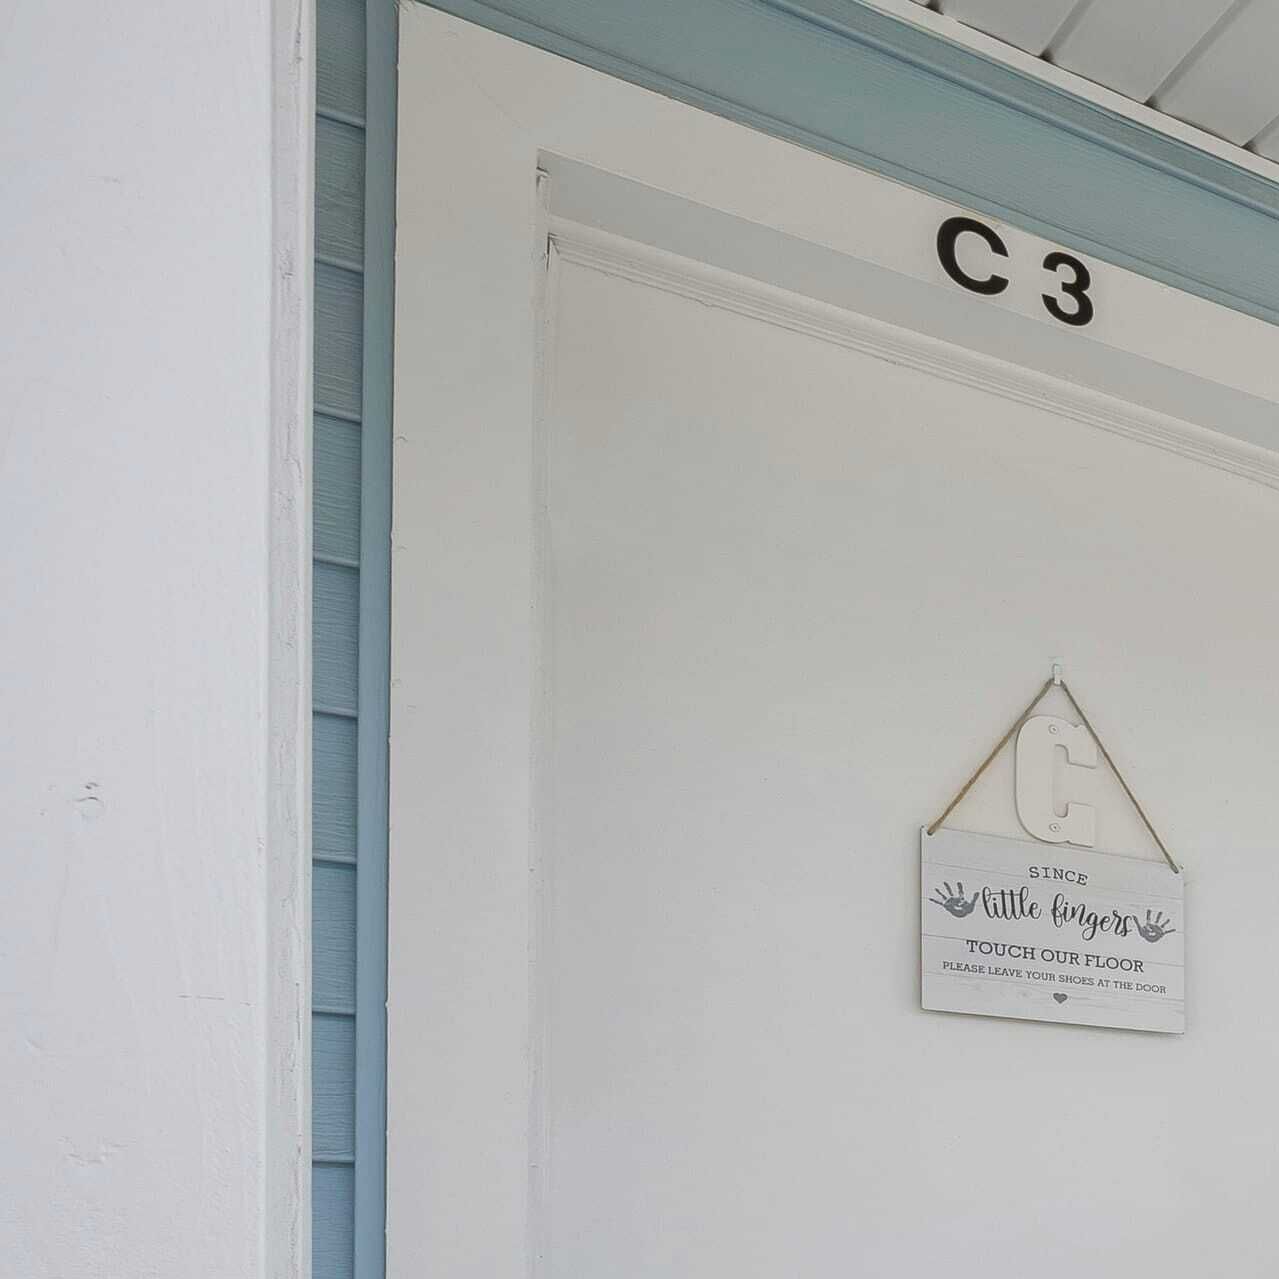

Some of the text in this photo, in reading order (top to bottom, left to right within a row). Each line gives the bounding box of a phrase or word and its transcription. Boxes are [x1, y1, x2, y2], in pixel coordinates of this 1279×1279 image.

[1028, 866, 1088, 886] SINCE
[982, 886, 1133, 941] little fingers
[966, 939, 1144, 973] TOUCH OUR FLOOR
[943, 961, 1167, 993] PLEASE LEAVE YOUR SHOES AT THE DOOR
